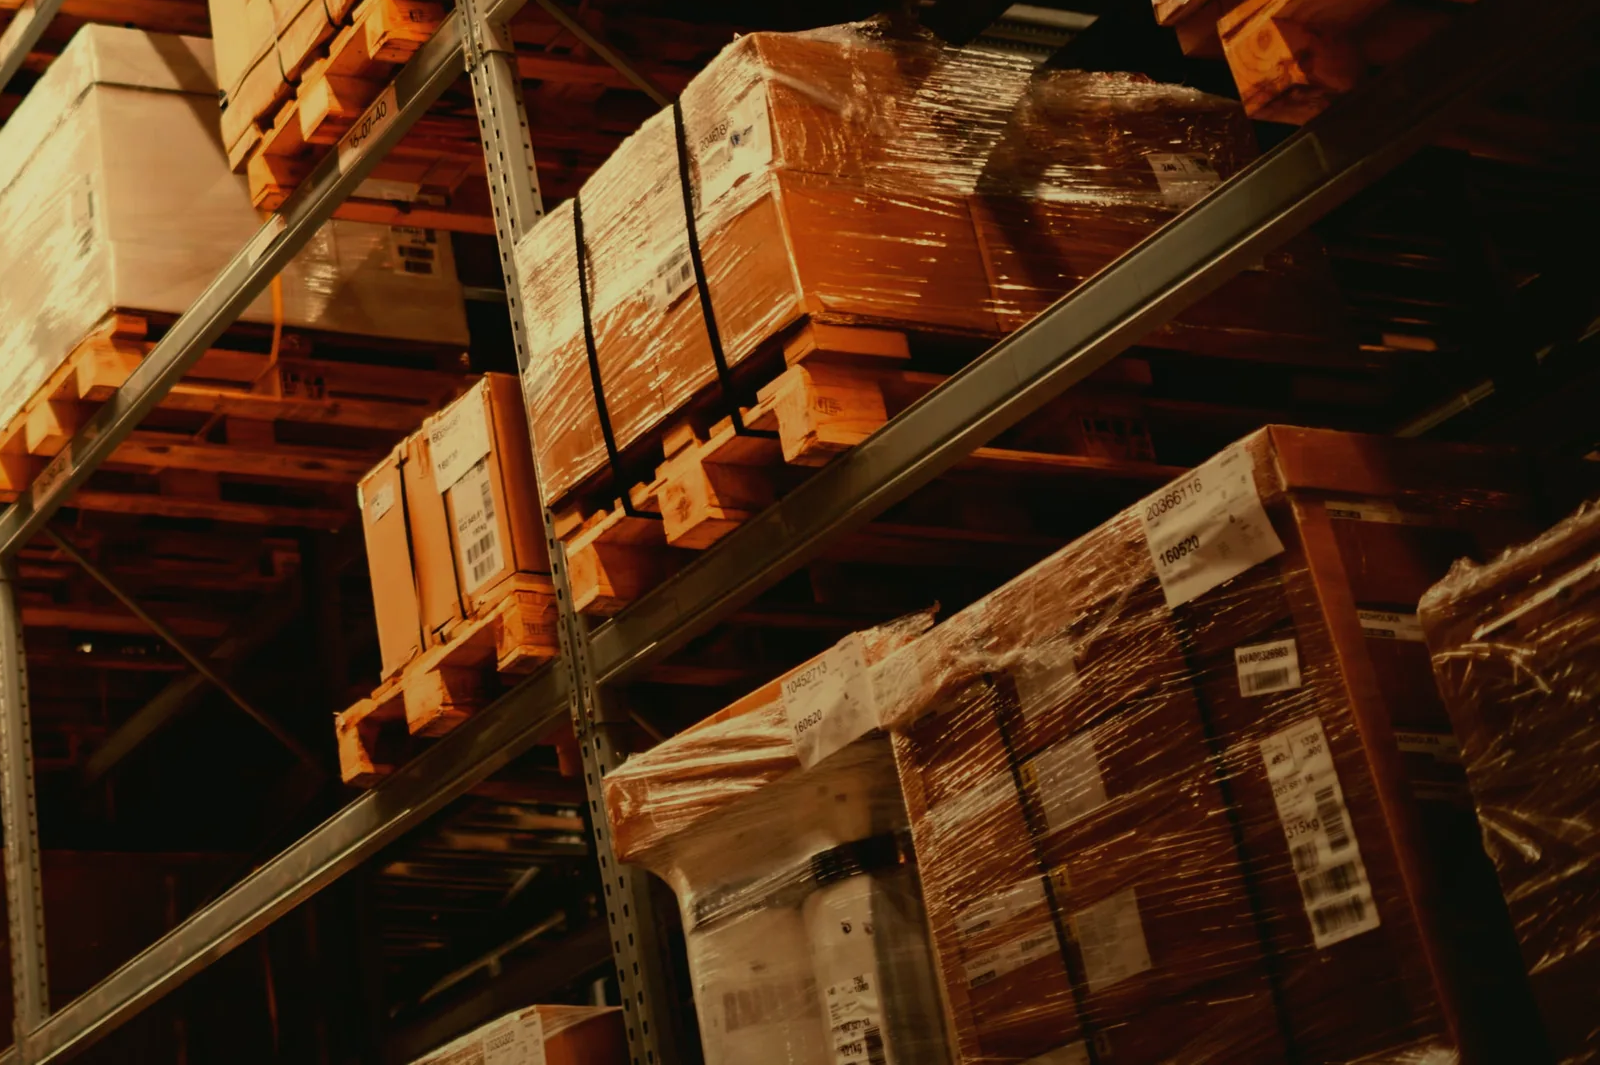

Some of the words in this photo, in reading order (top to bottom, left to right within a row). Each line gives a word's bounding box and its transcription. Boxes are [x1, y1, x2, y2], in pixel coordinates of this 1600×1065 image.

[349, 101, 387, 148] 16-07-40
[1146, 477, 1203, 522] 20366116
[1158, 533, 1201, 567] 160520
[786, 660, 828, 696] 10452713
[793, 708, 823, 737] 160620
[1286, 818, 1320, 839] 315kg
